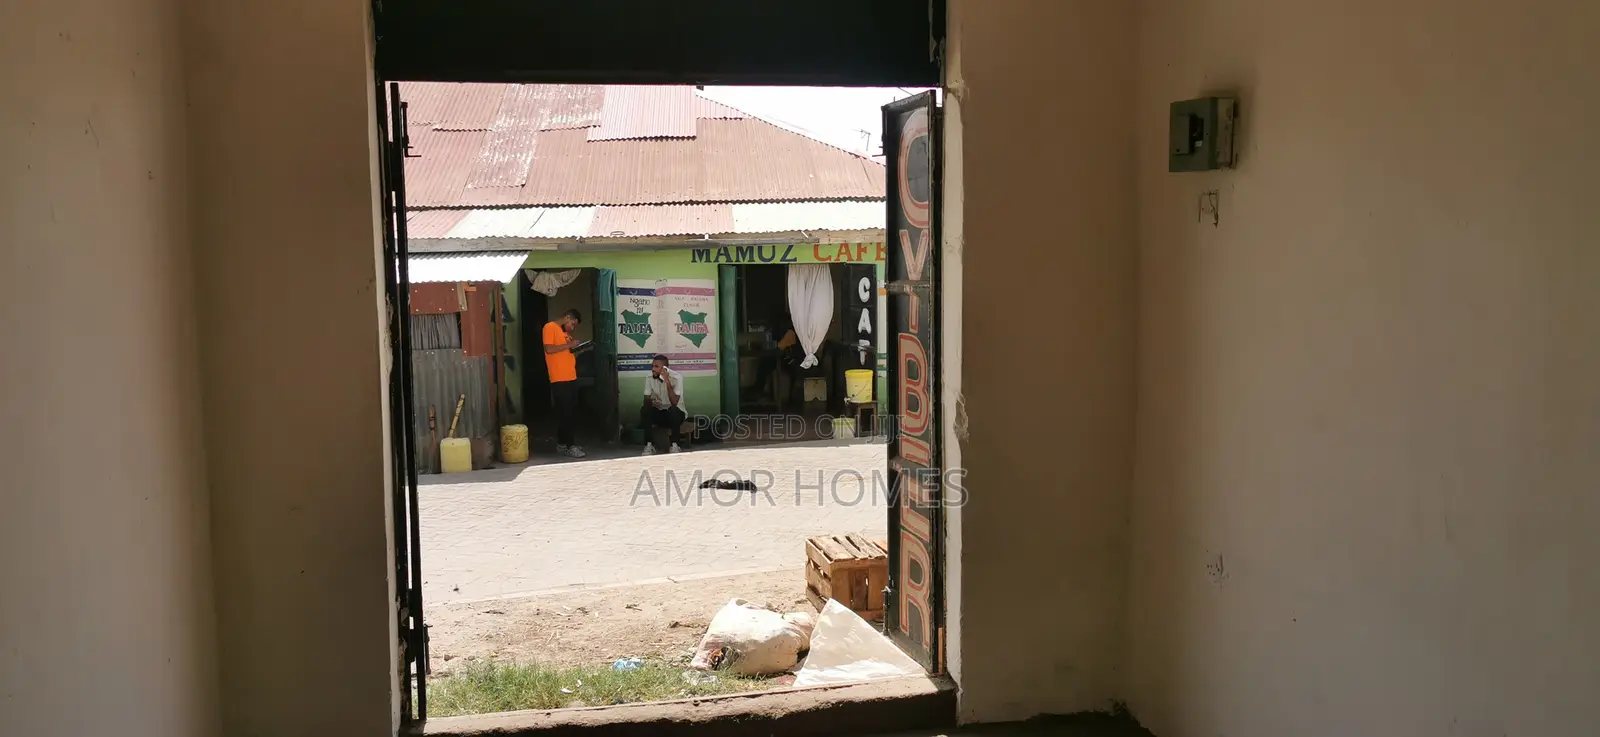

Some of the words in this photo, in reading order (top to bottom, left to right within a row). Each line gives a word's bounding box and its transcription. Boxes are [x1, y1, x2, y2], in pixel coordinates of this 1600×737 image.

[691, 244, 798, 263] MAMUZ
[618, 323, 654, 334] TAIFA
[674, 323, 710, 334] TAIFA
